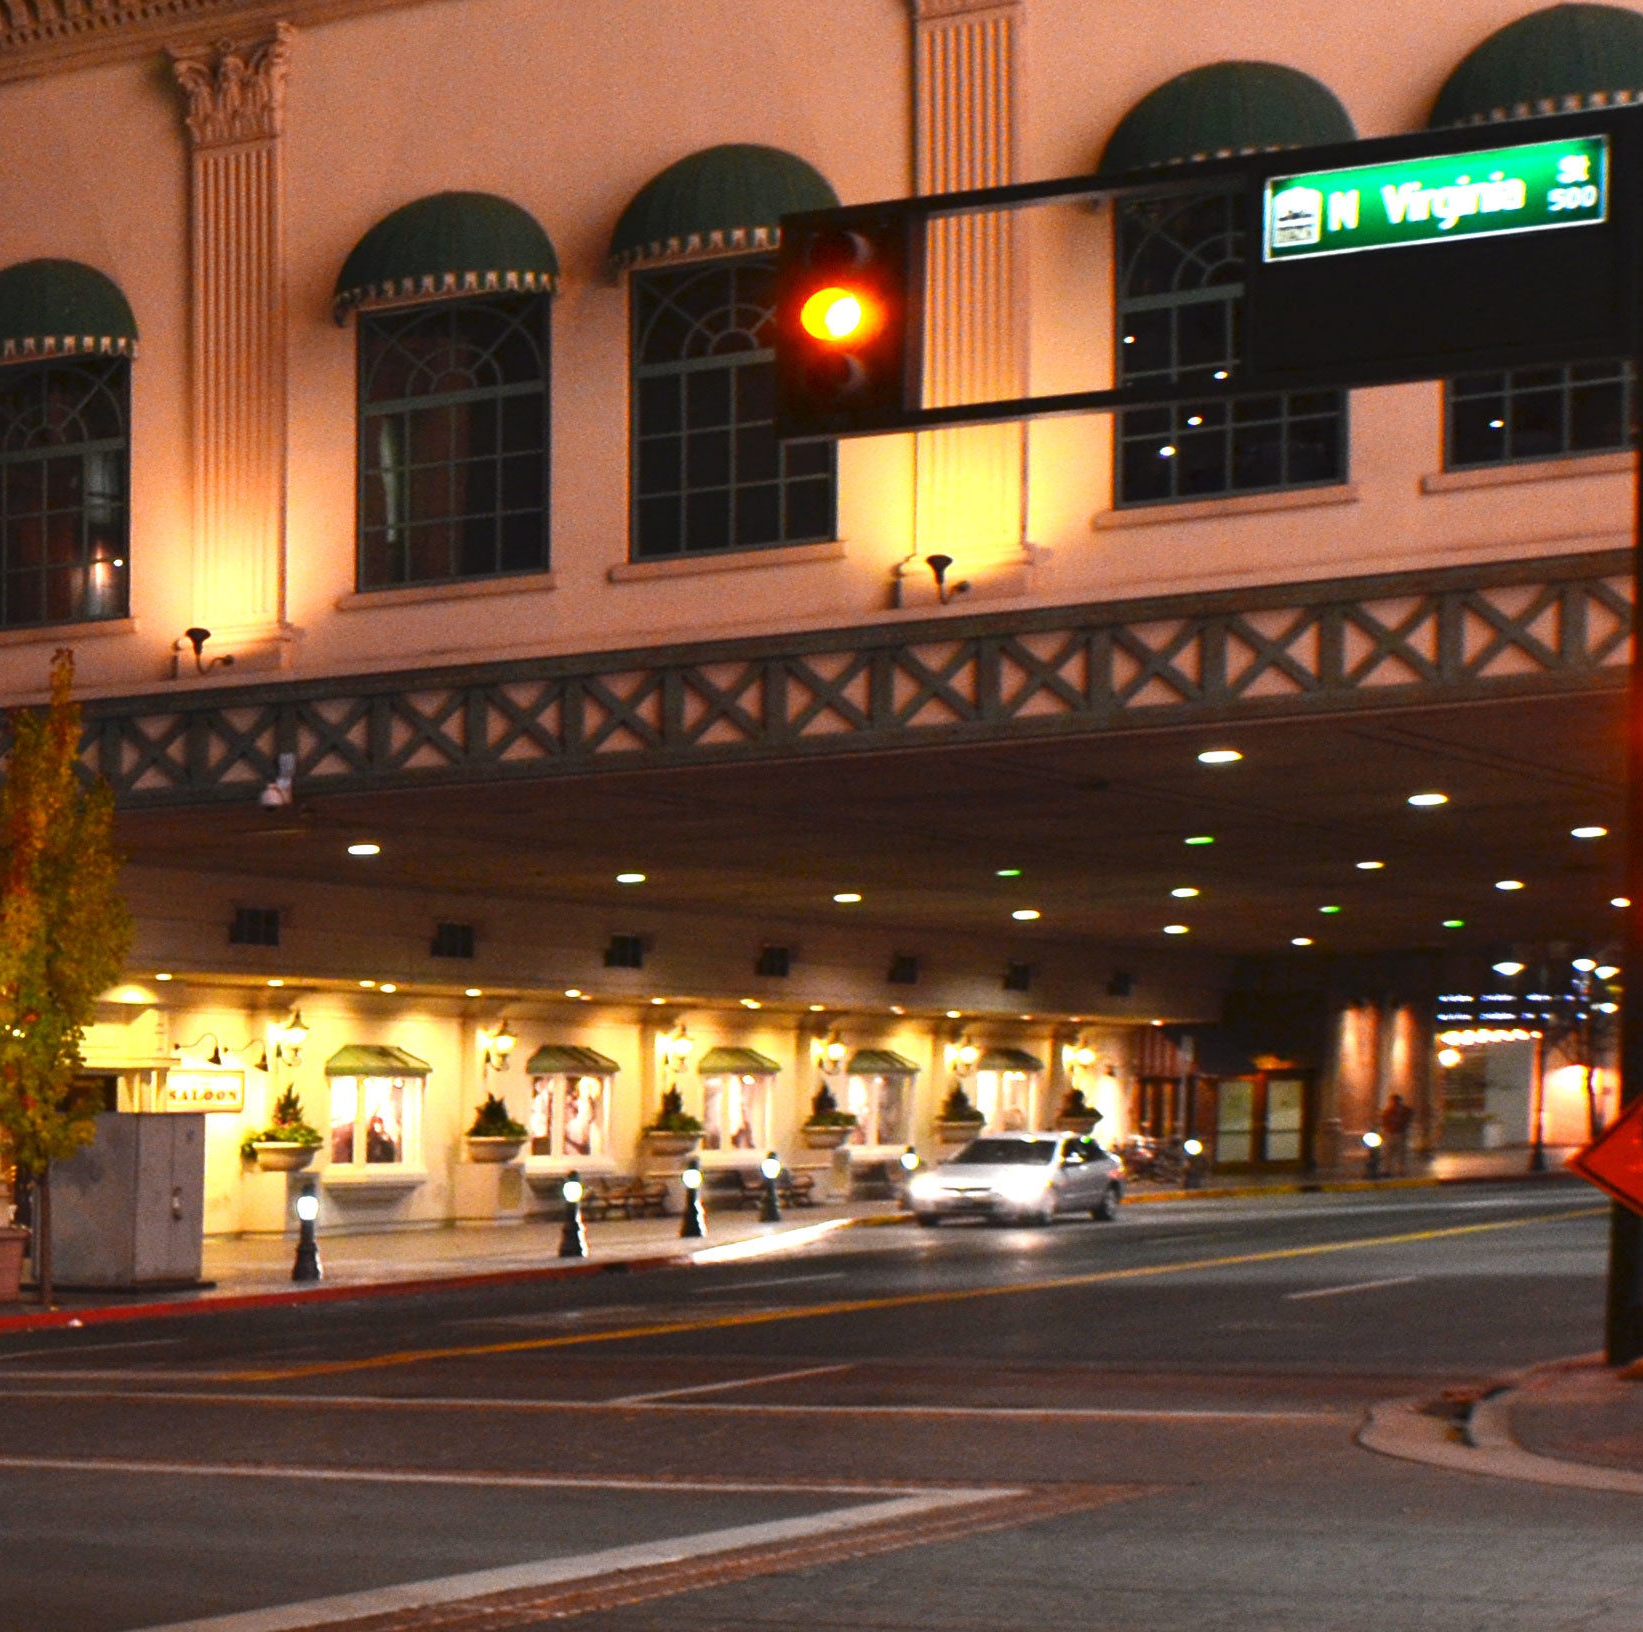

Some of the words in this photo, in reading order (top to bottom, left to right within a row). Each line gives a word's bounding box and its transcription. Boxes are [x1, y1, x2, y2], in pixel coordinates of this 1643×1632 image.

[1327, 189, 1360, 232] N
[1382, 171, 1527, 230] Virginia
[1546, 186, 1597, 211] 500
